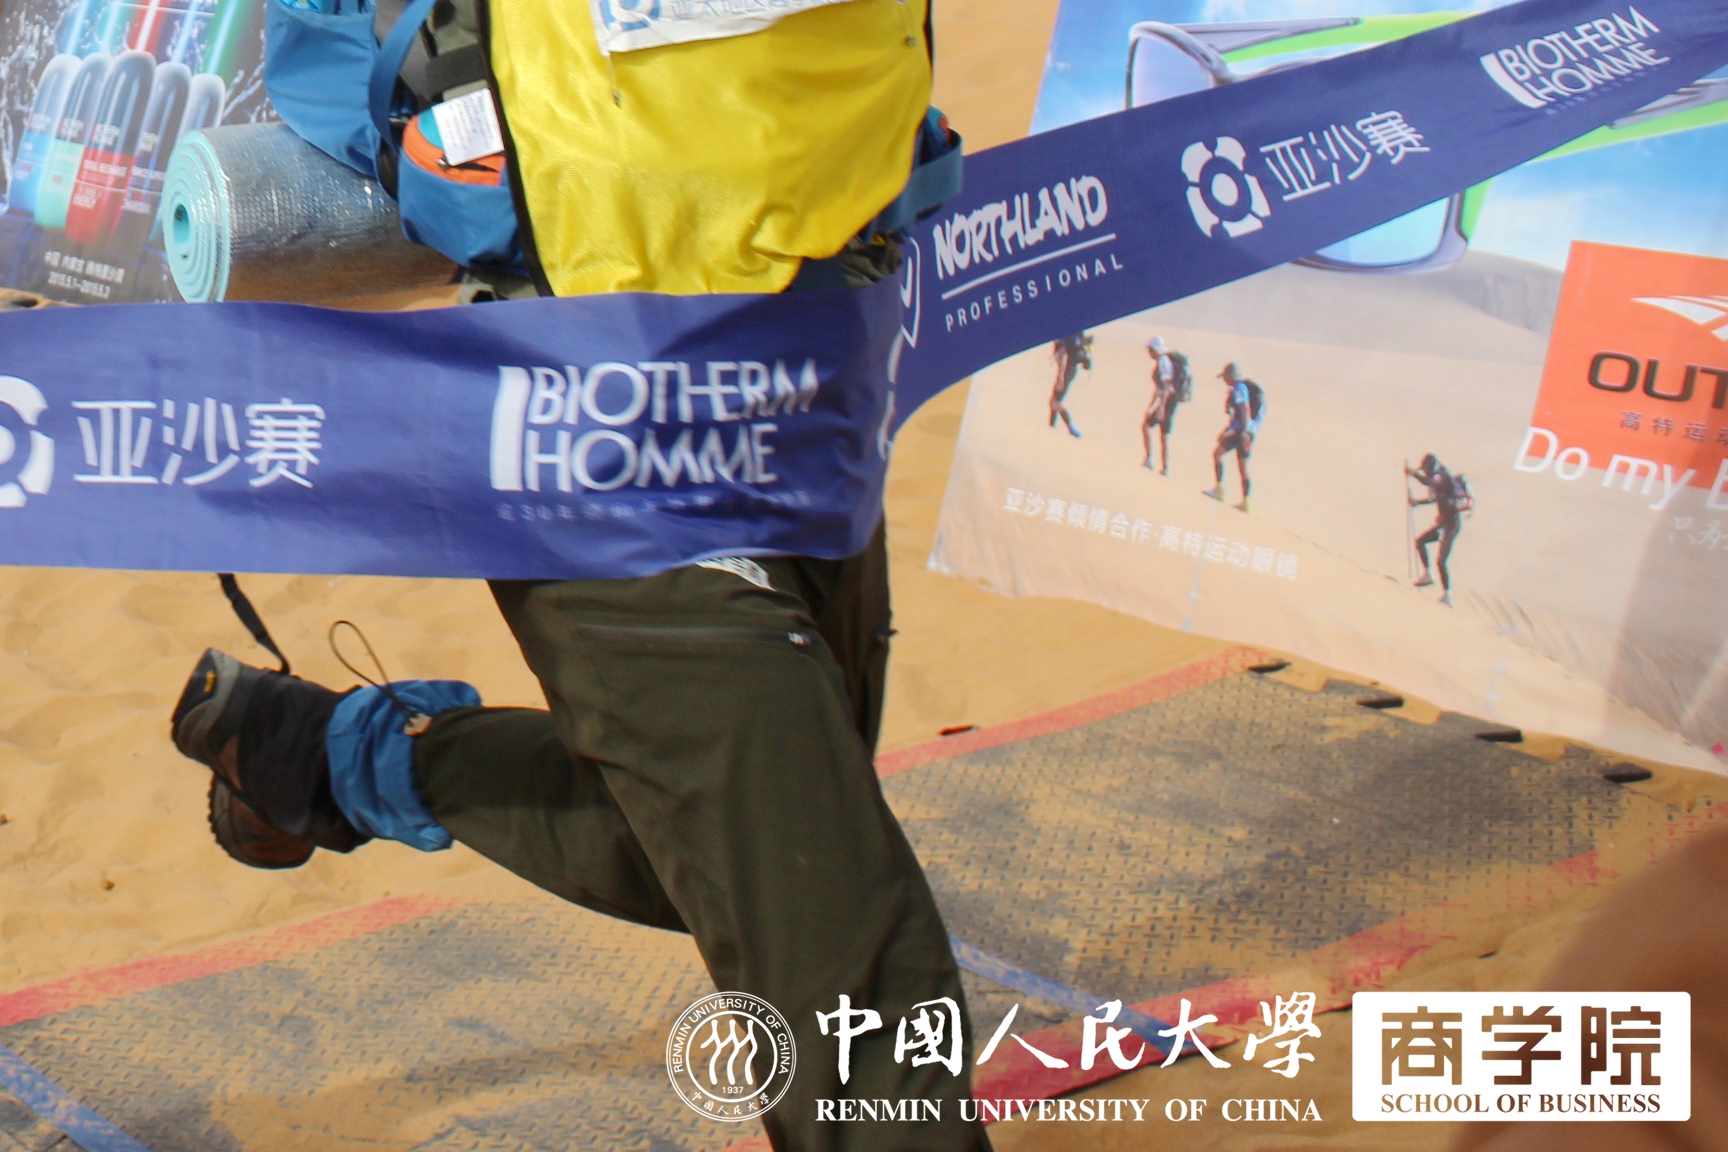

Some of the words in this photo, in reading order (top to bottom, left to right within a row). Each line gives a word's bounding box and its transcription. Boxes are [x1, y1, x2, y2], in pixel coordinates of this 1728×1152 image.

[1500, 5, 1662, 83] BIOTHERM
[1522, 41, 1671, 103] HOMME
[1259, 109, 1430, 203] 亚沙赛
[933, 174, 1109, 281] NORTHLAND
[945, 252, 1124, 333] PROFESSIONAL
[526, 358, 820, 427] BIOTHERM
[71, 397, 327, 489] 亚沙赛
[522, 422, 780, 493] HOMME
[1513, 425, 1590, 481] Do
[1600, 453, 1697, 511] my
